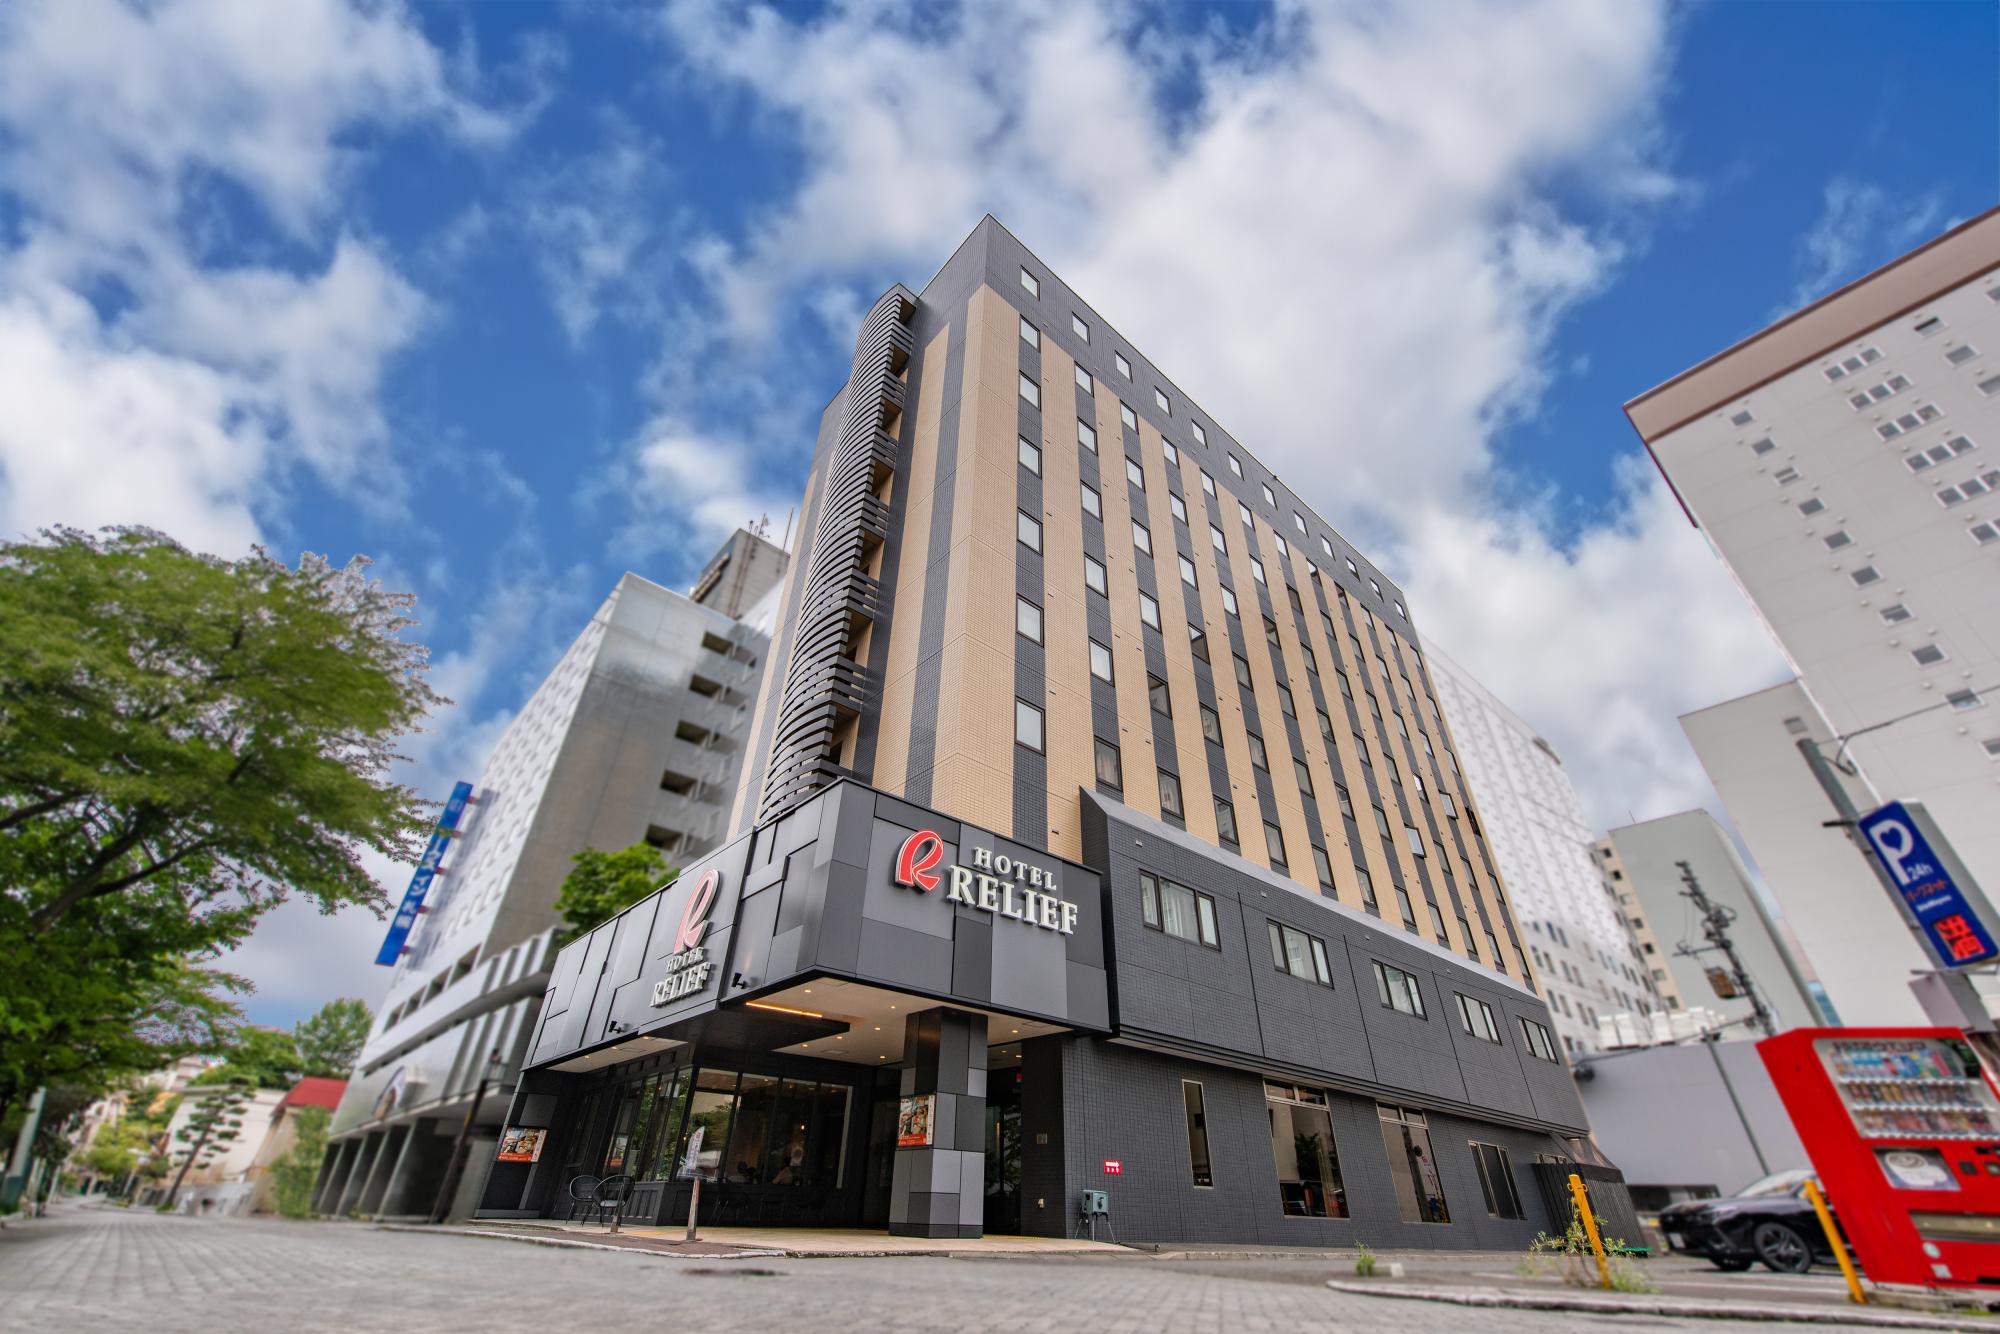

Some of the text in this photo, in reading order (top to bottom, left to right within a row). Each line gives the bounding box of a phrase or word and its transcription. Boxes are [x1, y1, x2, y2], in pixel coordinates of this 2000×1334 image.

[973, 846, 1057, 891] HOTEL
[1869, 819, 1913, 885] P
[1907, 863, 1933, 880] 24h
[946, 864, 1078, 935] RELIEF
[666, 947, 706, 974] HOTEL
[650, 962, 711, 1008] RELIEF
